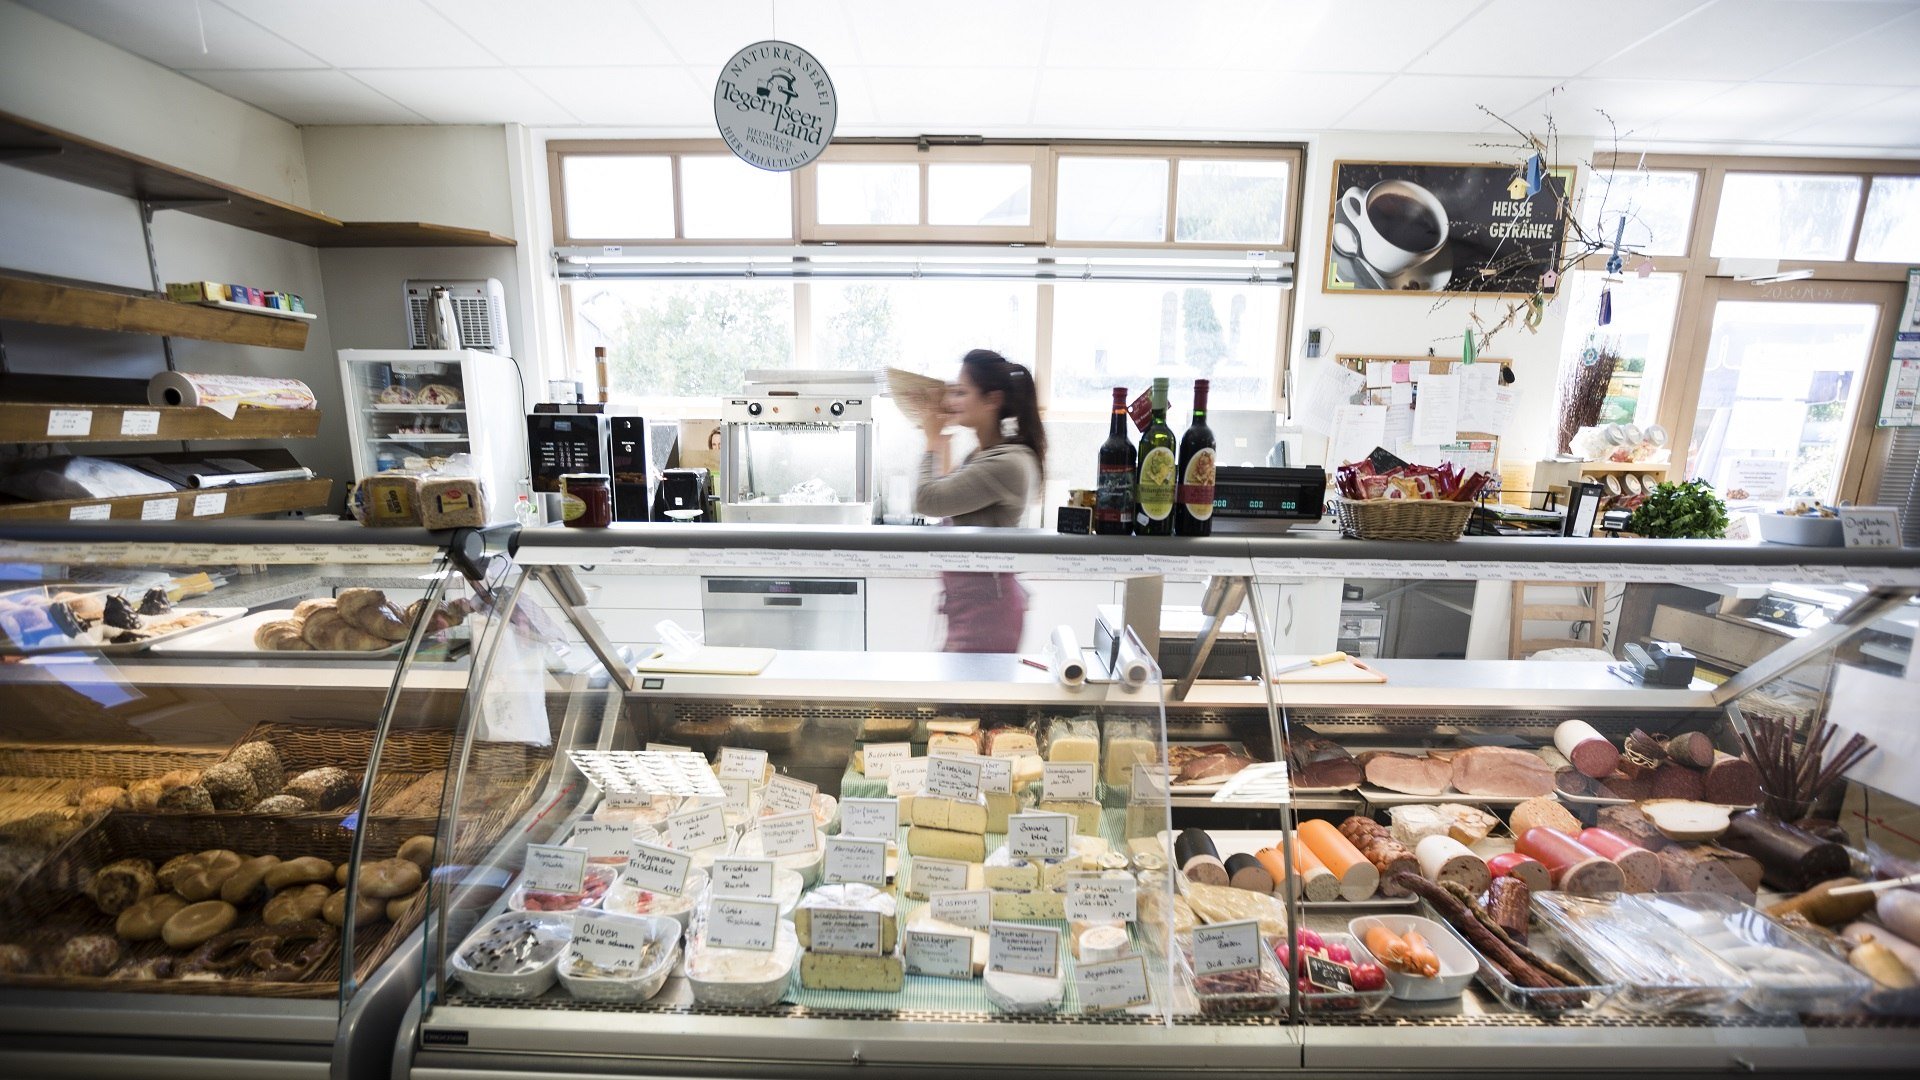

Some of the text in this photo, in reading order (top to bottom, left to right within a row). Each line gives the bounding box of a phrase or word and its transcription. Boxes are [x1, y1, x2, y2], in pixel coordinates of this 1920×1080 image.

[731, 46, 829, 107] NATURKÄSEREI
[721, 80, 822, 129] Tegernseer
[774, 122, 823, 146] Land
[723, 126, 809, 168] HIER ERHÄLTLICH
[746, 135, 791, 155] PRODUKTE
[1491, 201, 1533, 218] HEISSE
[1489, 218, 1553, 239] GETRÄNKE
[629, 859, 673, 876] Frischkäse
[638, 850, 676, 866] Peppadew
[583, 923, 619, 938] Oliven
[573, 936, 592, 946] grün
